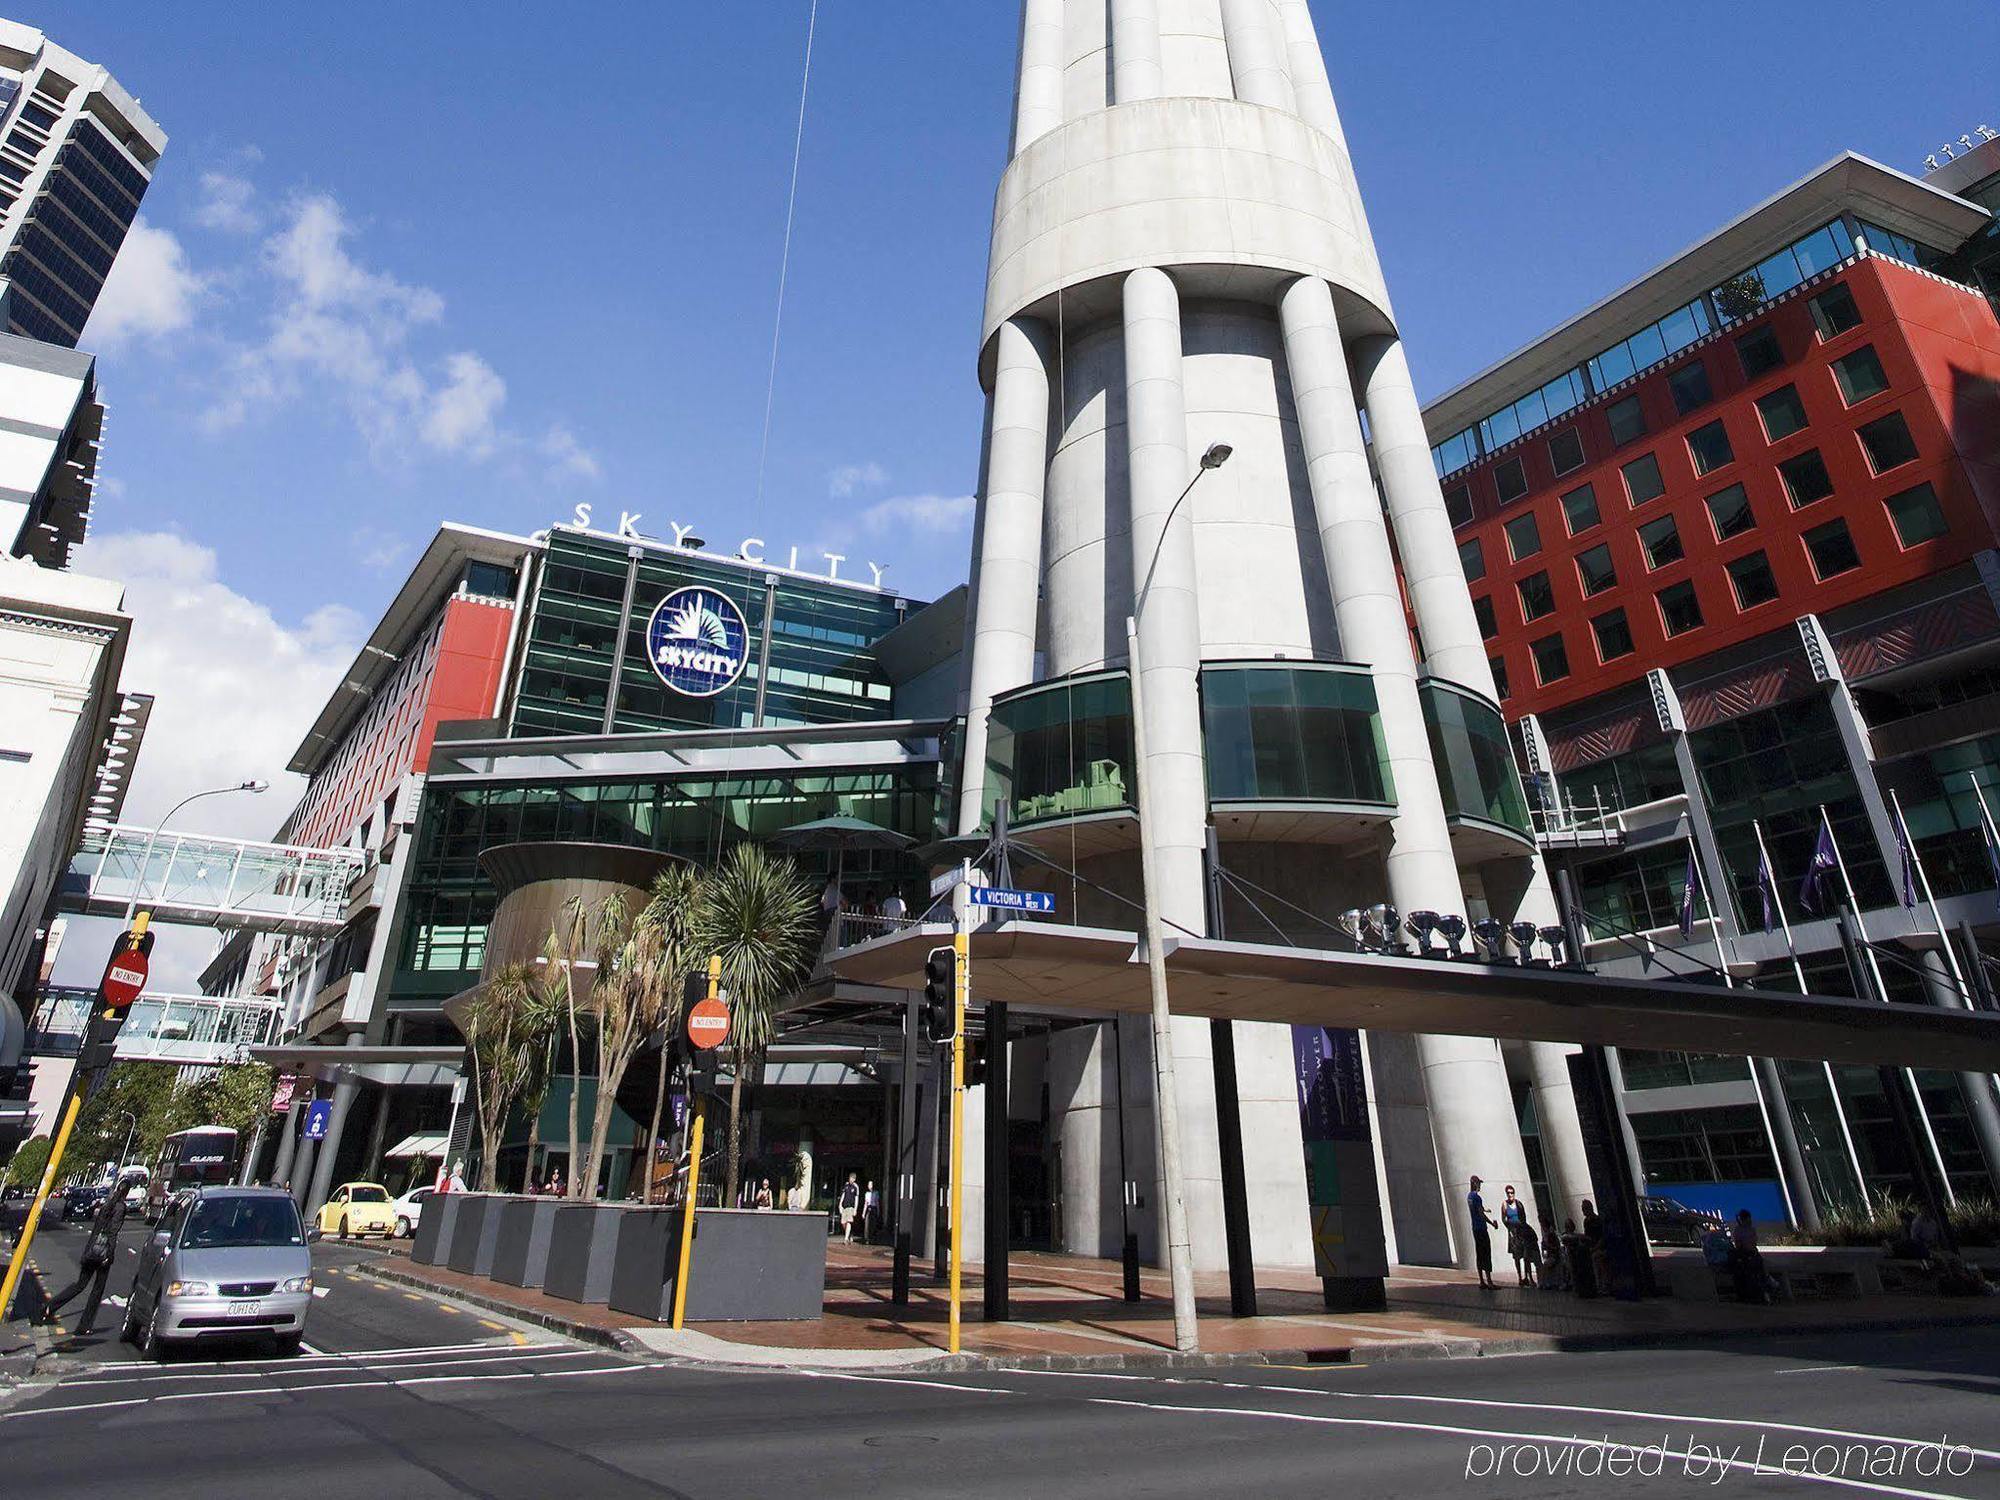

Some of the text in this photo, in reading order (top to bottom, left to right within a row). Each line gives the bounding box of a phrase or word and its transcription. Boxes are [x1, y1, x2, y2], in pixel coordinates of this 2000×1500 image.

[573, 503, 886, 587] SKY CITY
[657, 645, 738, 677] SKYCITY
[986, 890, 1023, 907] VICTORIA
[114, 970, 140, 983] NO ENTRY
[695, 1018, 722, 1027] NO ENTRY
